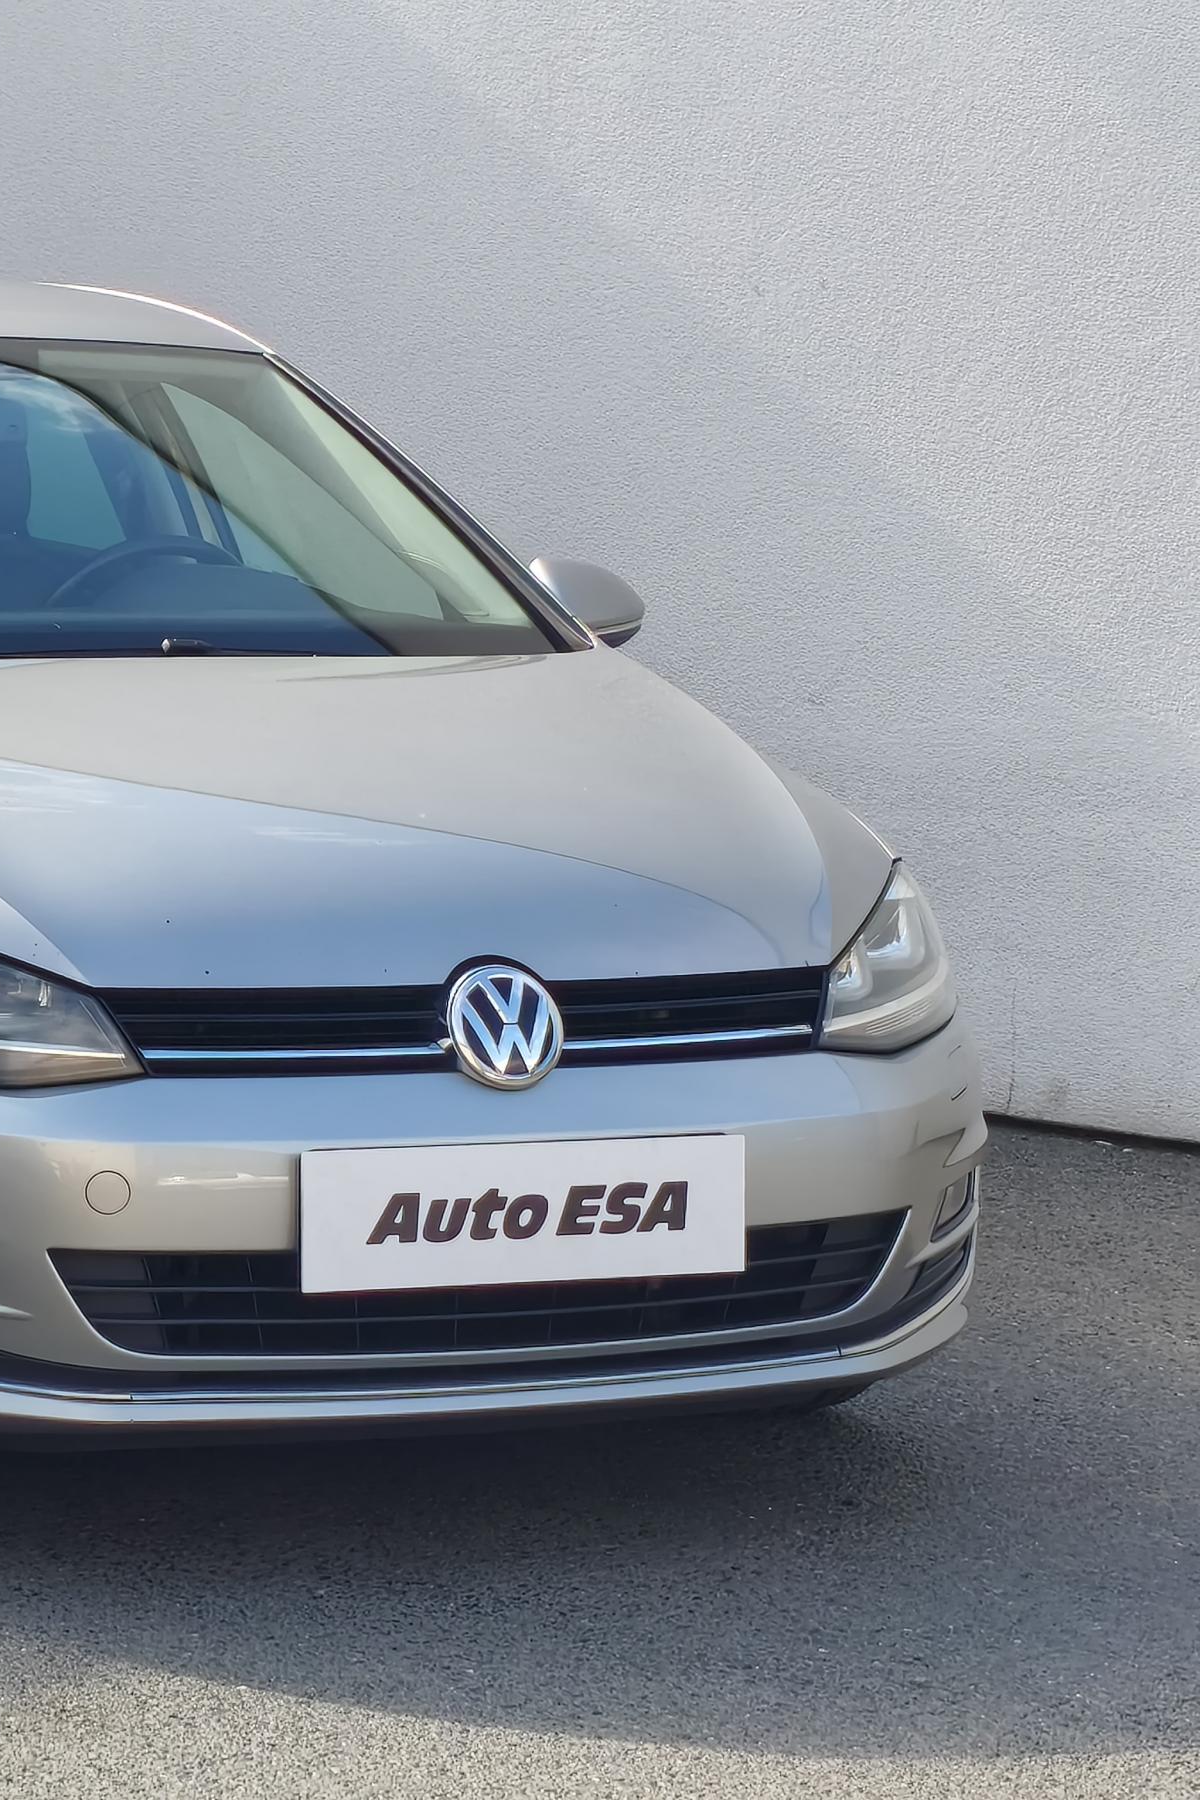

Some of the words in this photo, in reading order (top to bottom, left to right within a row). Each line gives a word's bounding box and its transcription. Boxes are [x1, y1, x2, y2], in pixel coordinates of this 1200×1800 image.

[452, 966, 558, 1082] VW
[365, 1188, 549, 1245] Auto
[555, 1180, 689, 1237] ESA
